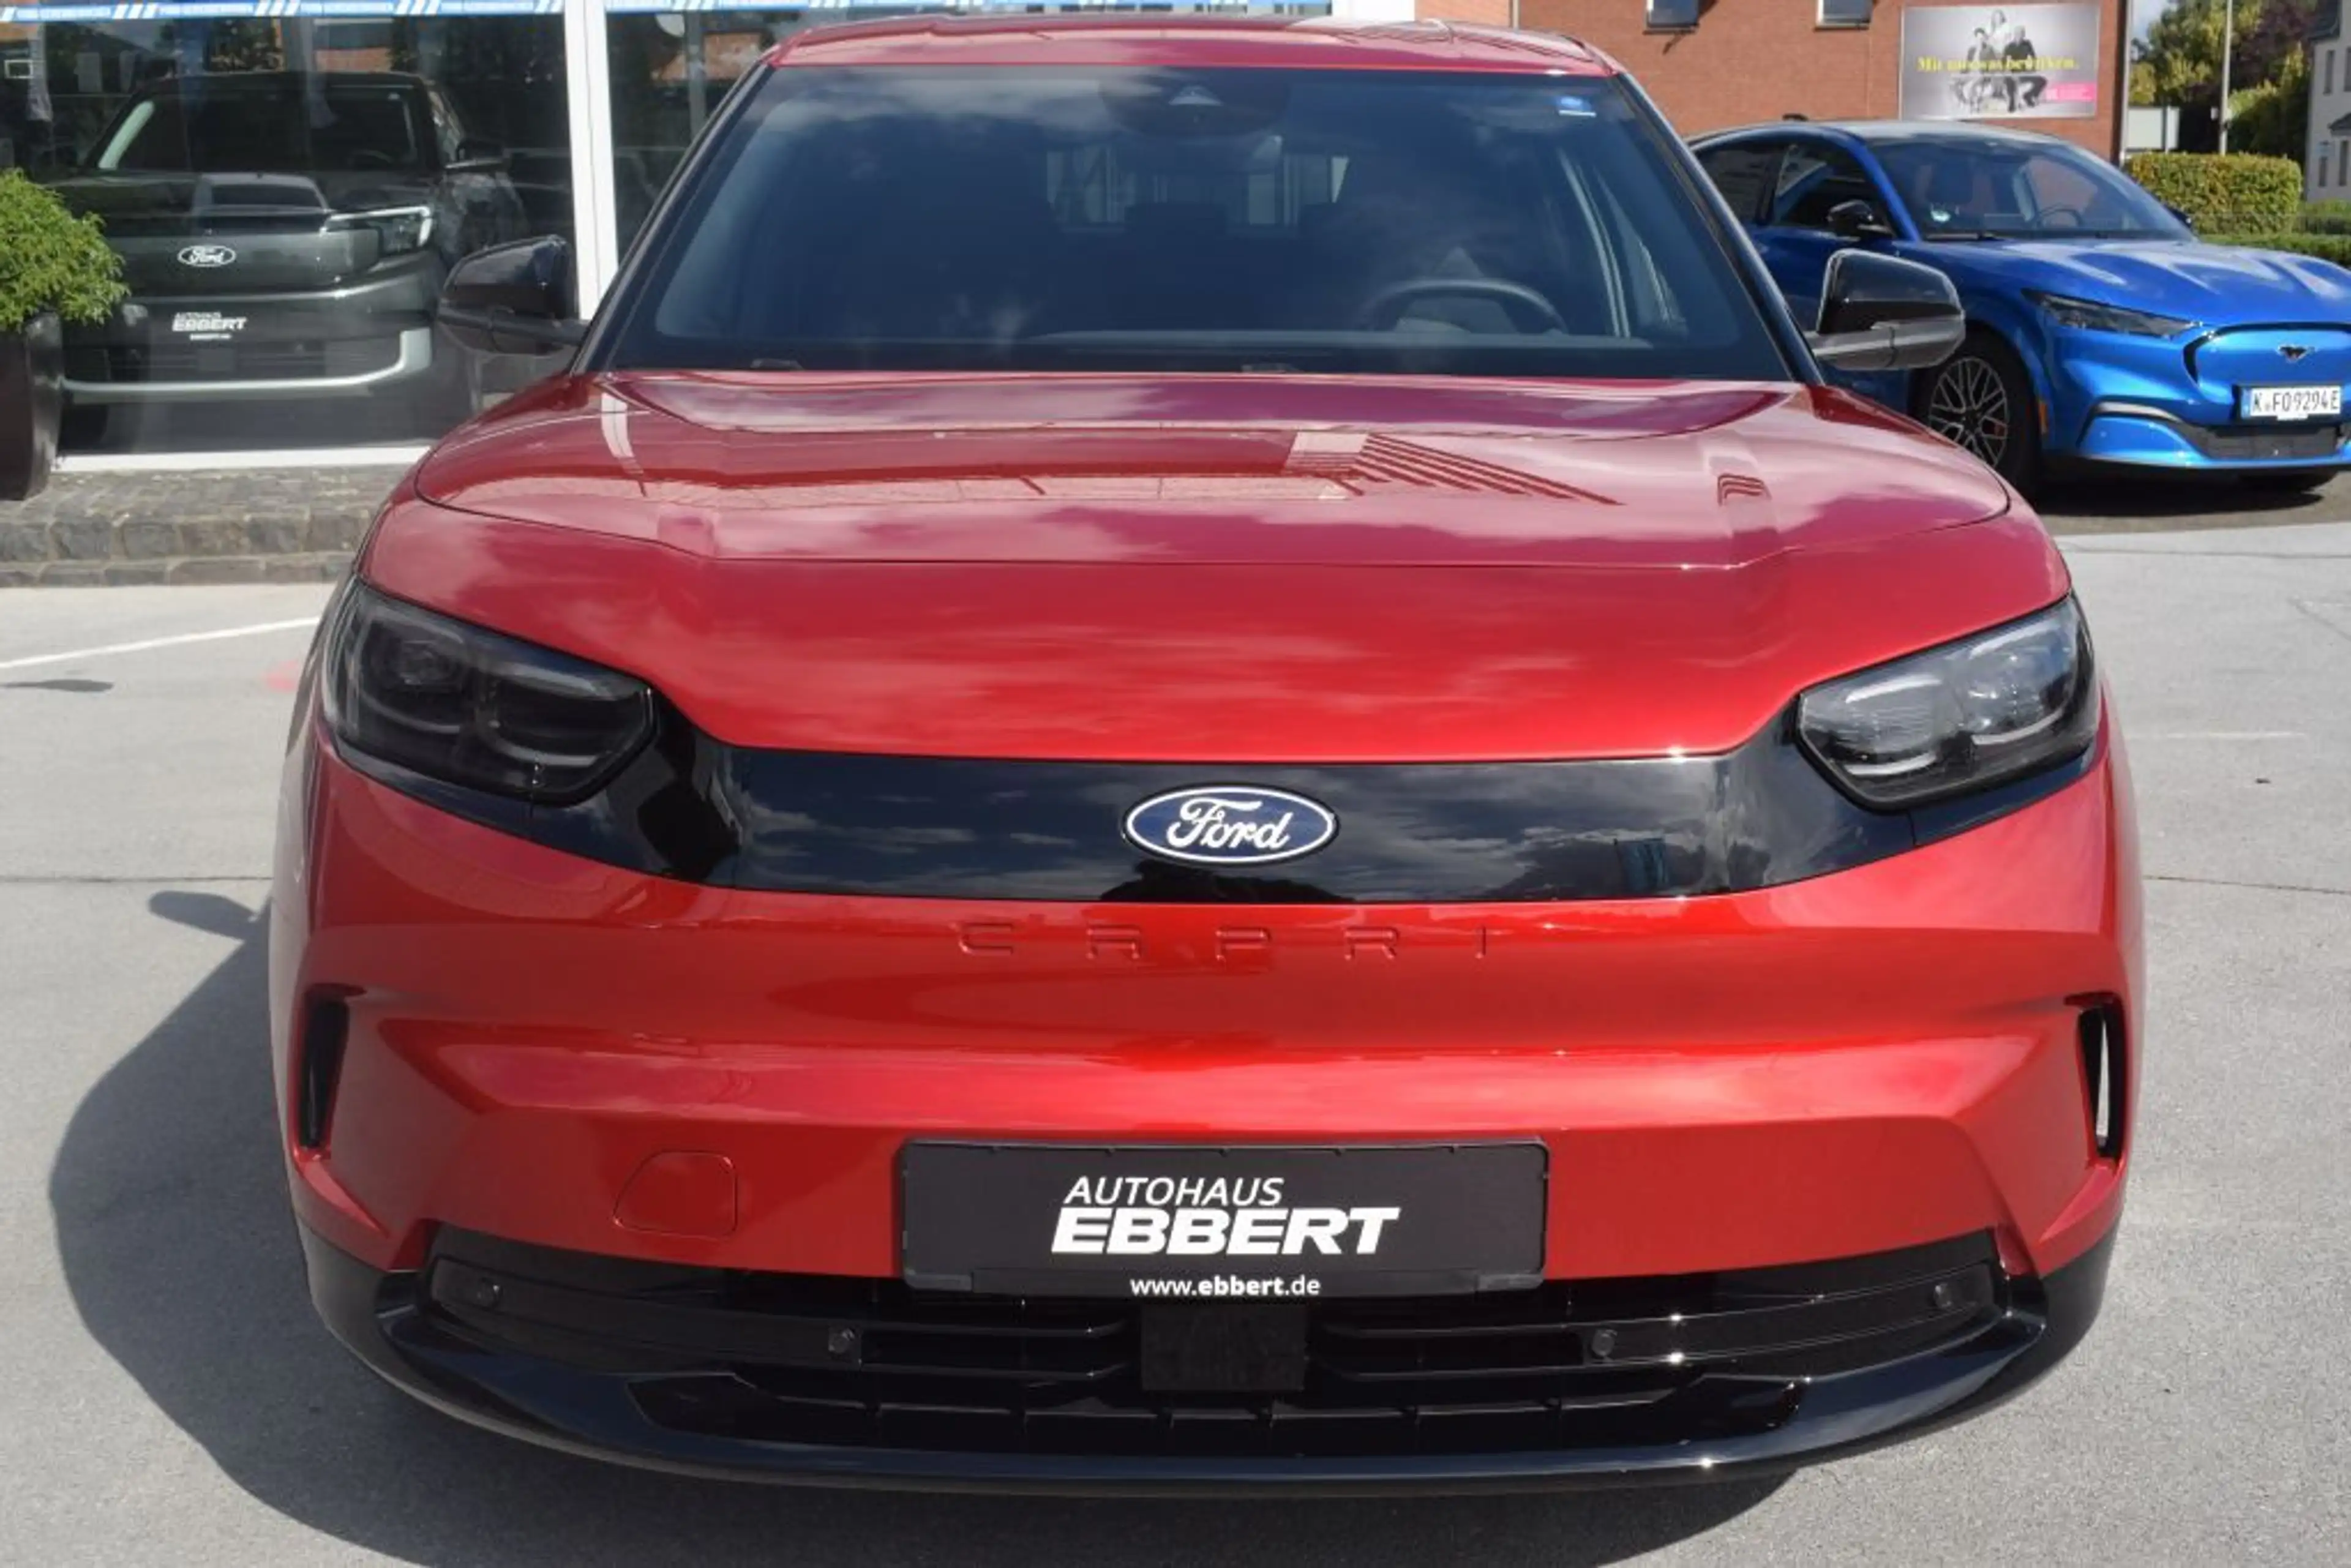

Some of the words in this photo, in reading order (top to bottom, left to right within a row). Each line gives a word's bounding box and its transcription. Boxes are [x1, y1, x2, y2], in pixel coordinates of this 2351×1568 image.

[1166, 797, 1294, 849] Ford
[958, 921, 1487, 960] CAPRI
[1063, 1176, 1285, 1206] AUTOHAUS
[1051, 1207, 1402, 1255] EBBERT
[1130, 1275, 1321, 1296] www.ebbert.de
